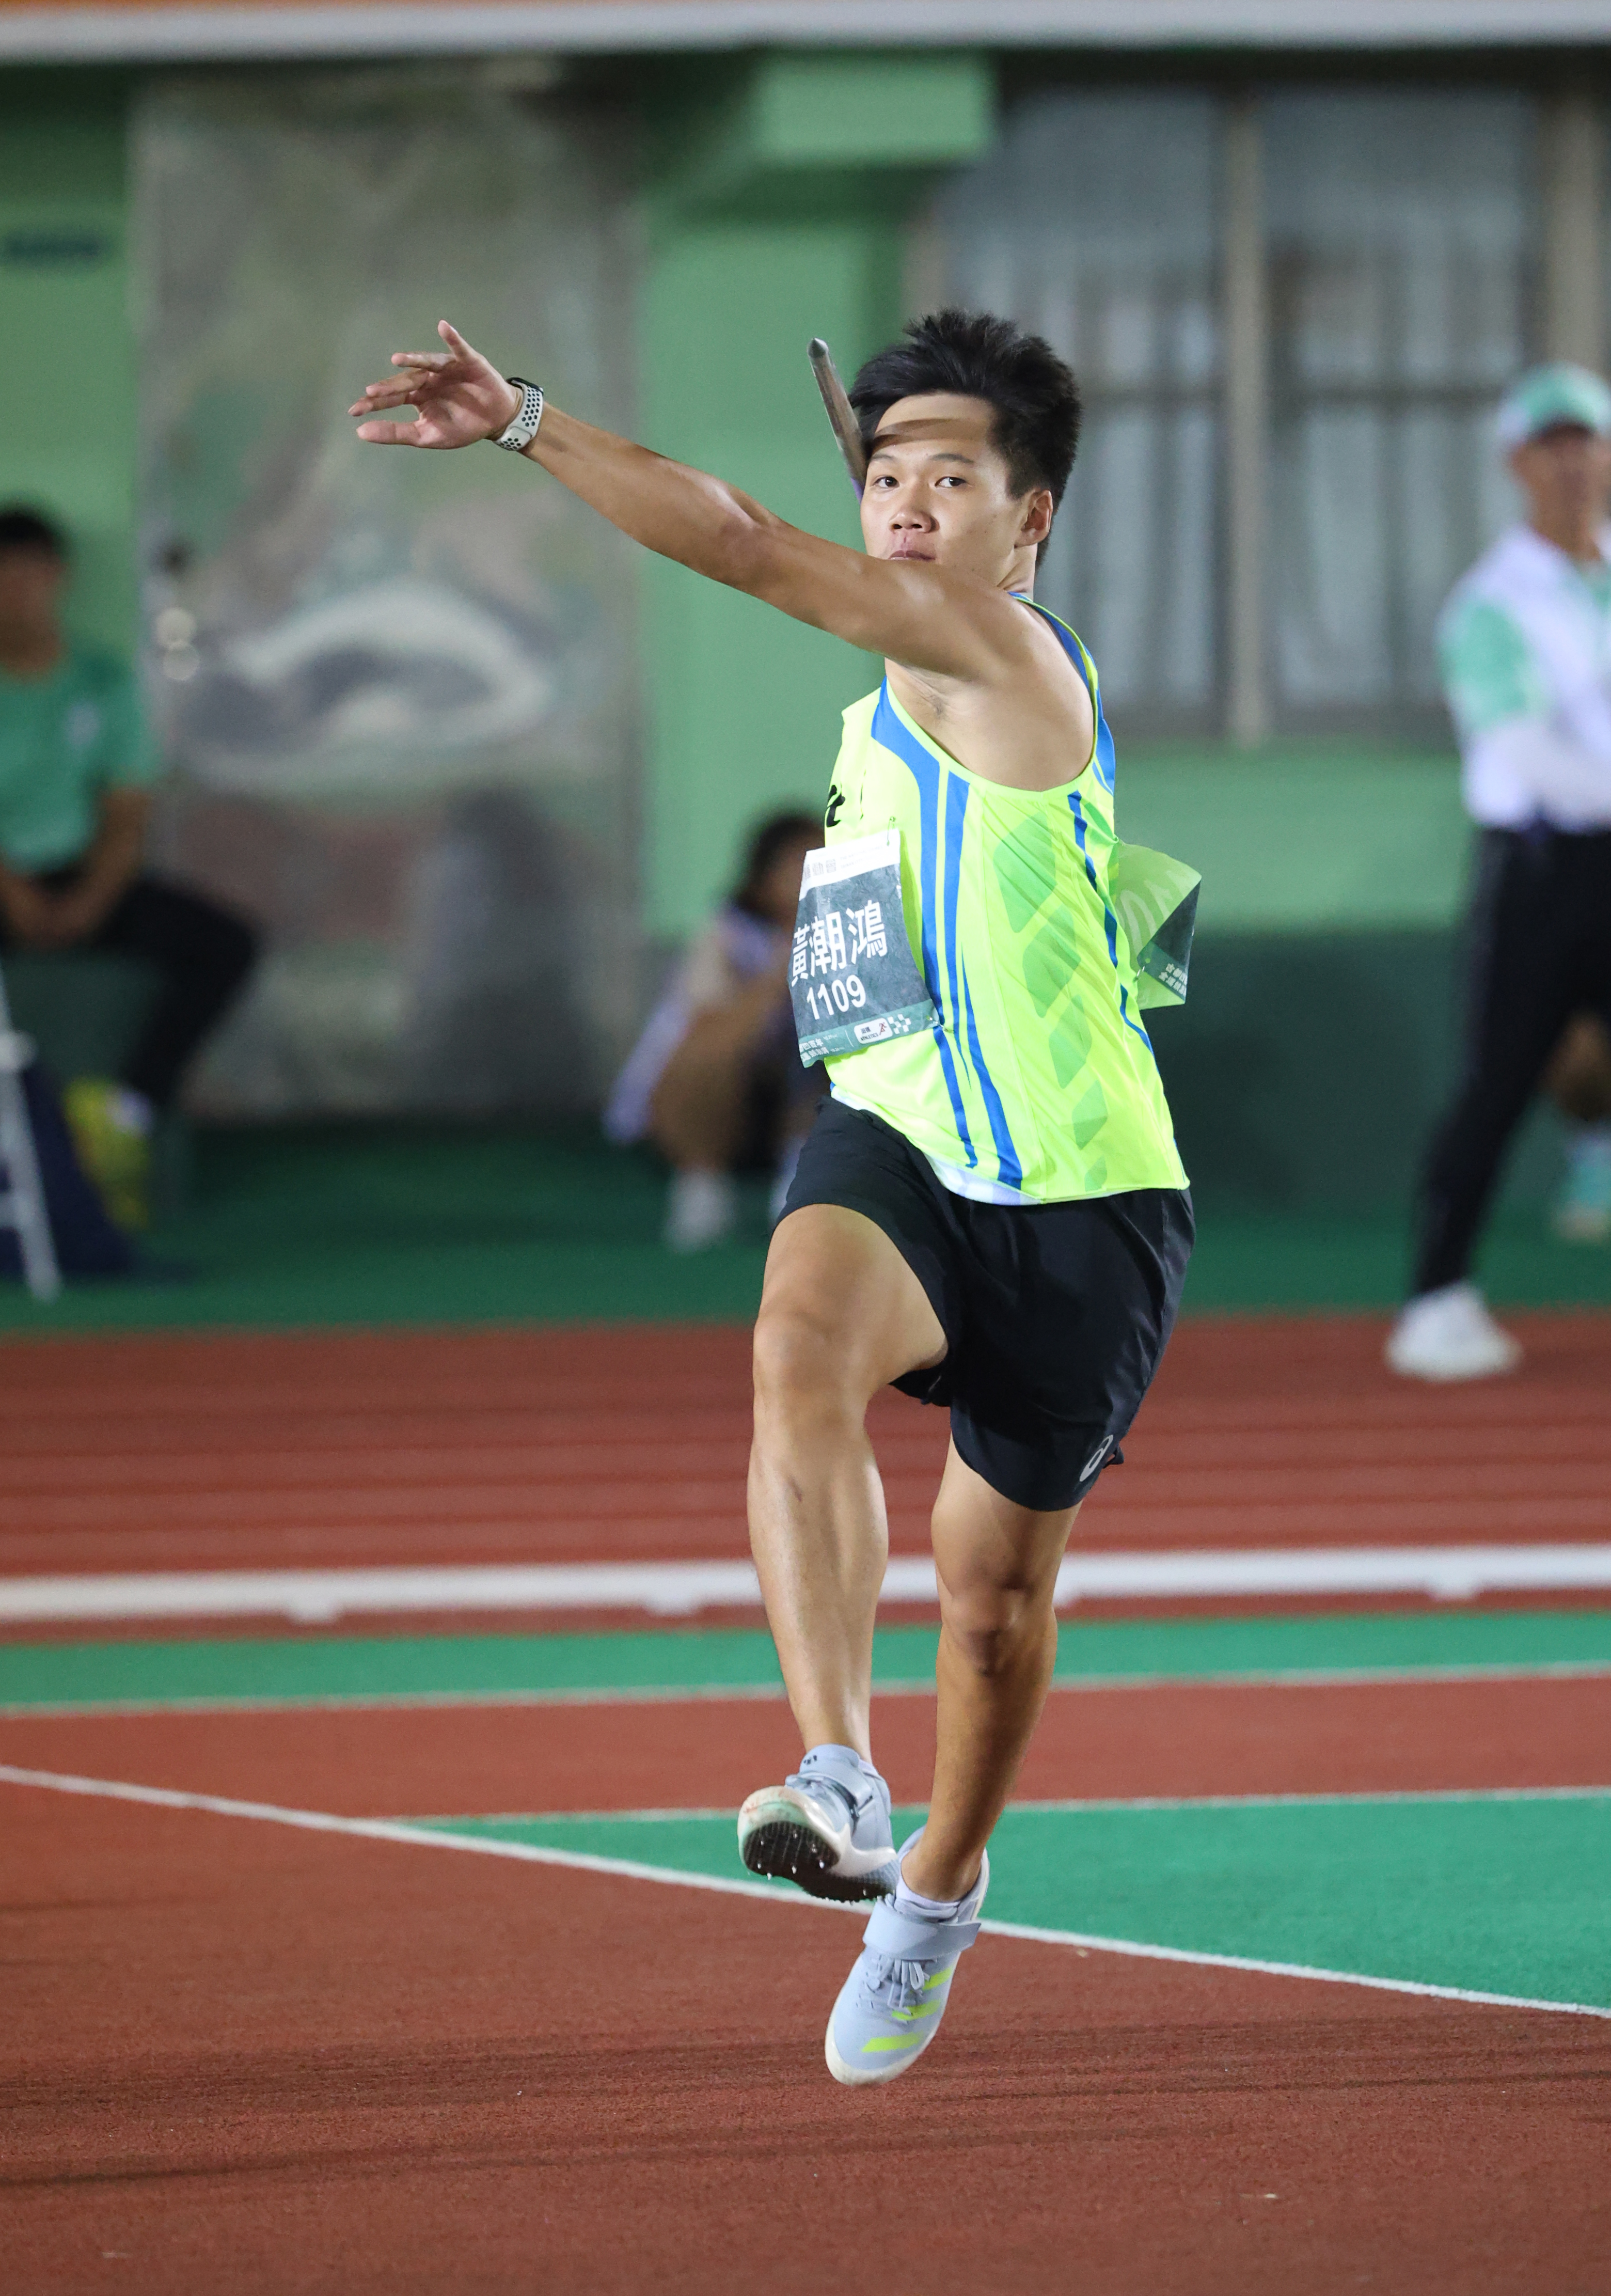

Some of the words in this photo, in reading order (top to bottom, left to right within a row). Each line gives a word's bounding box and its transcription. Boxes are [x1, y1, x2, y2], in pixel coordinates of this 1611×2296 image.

[791, 899, 888, 987] 黃潮鴻
[806, 974, 867, 1020] 1109
